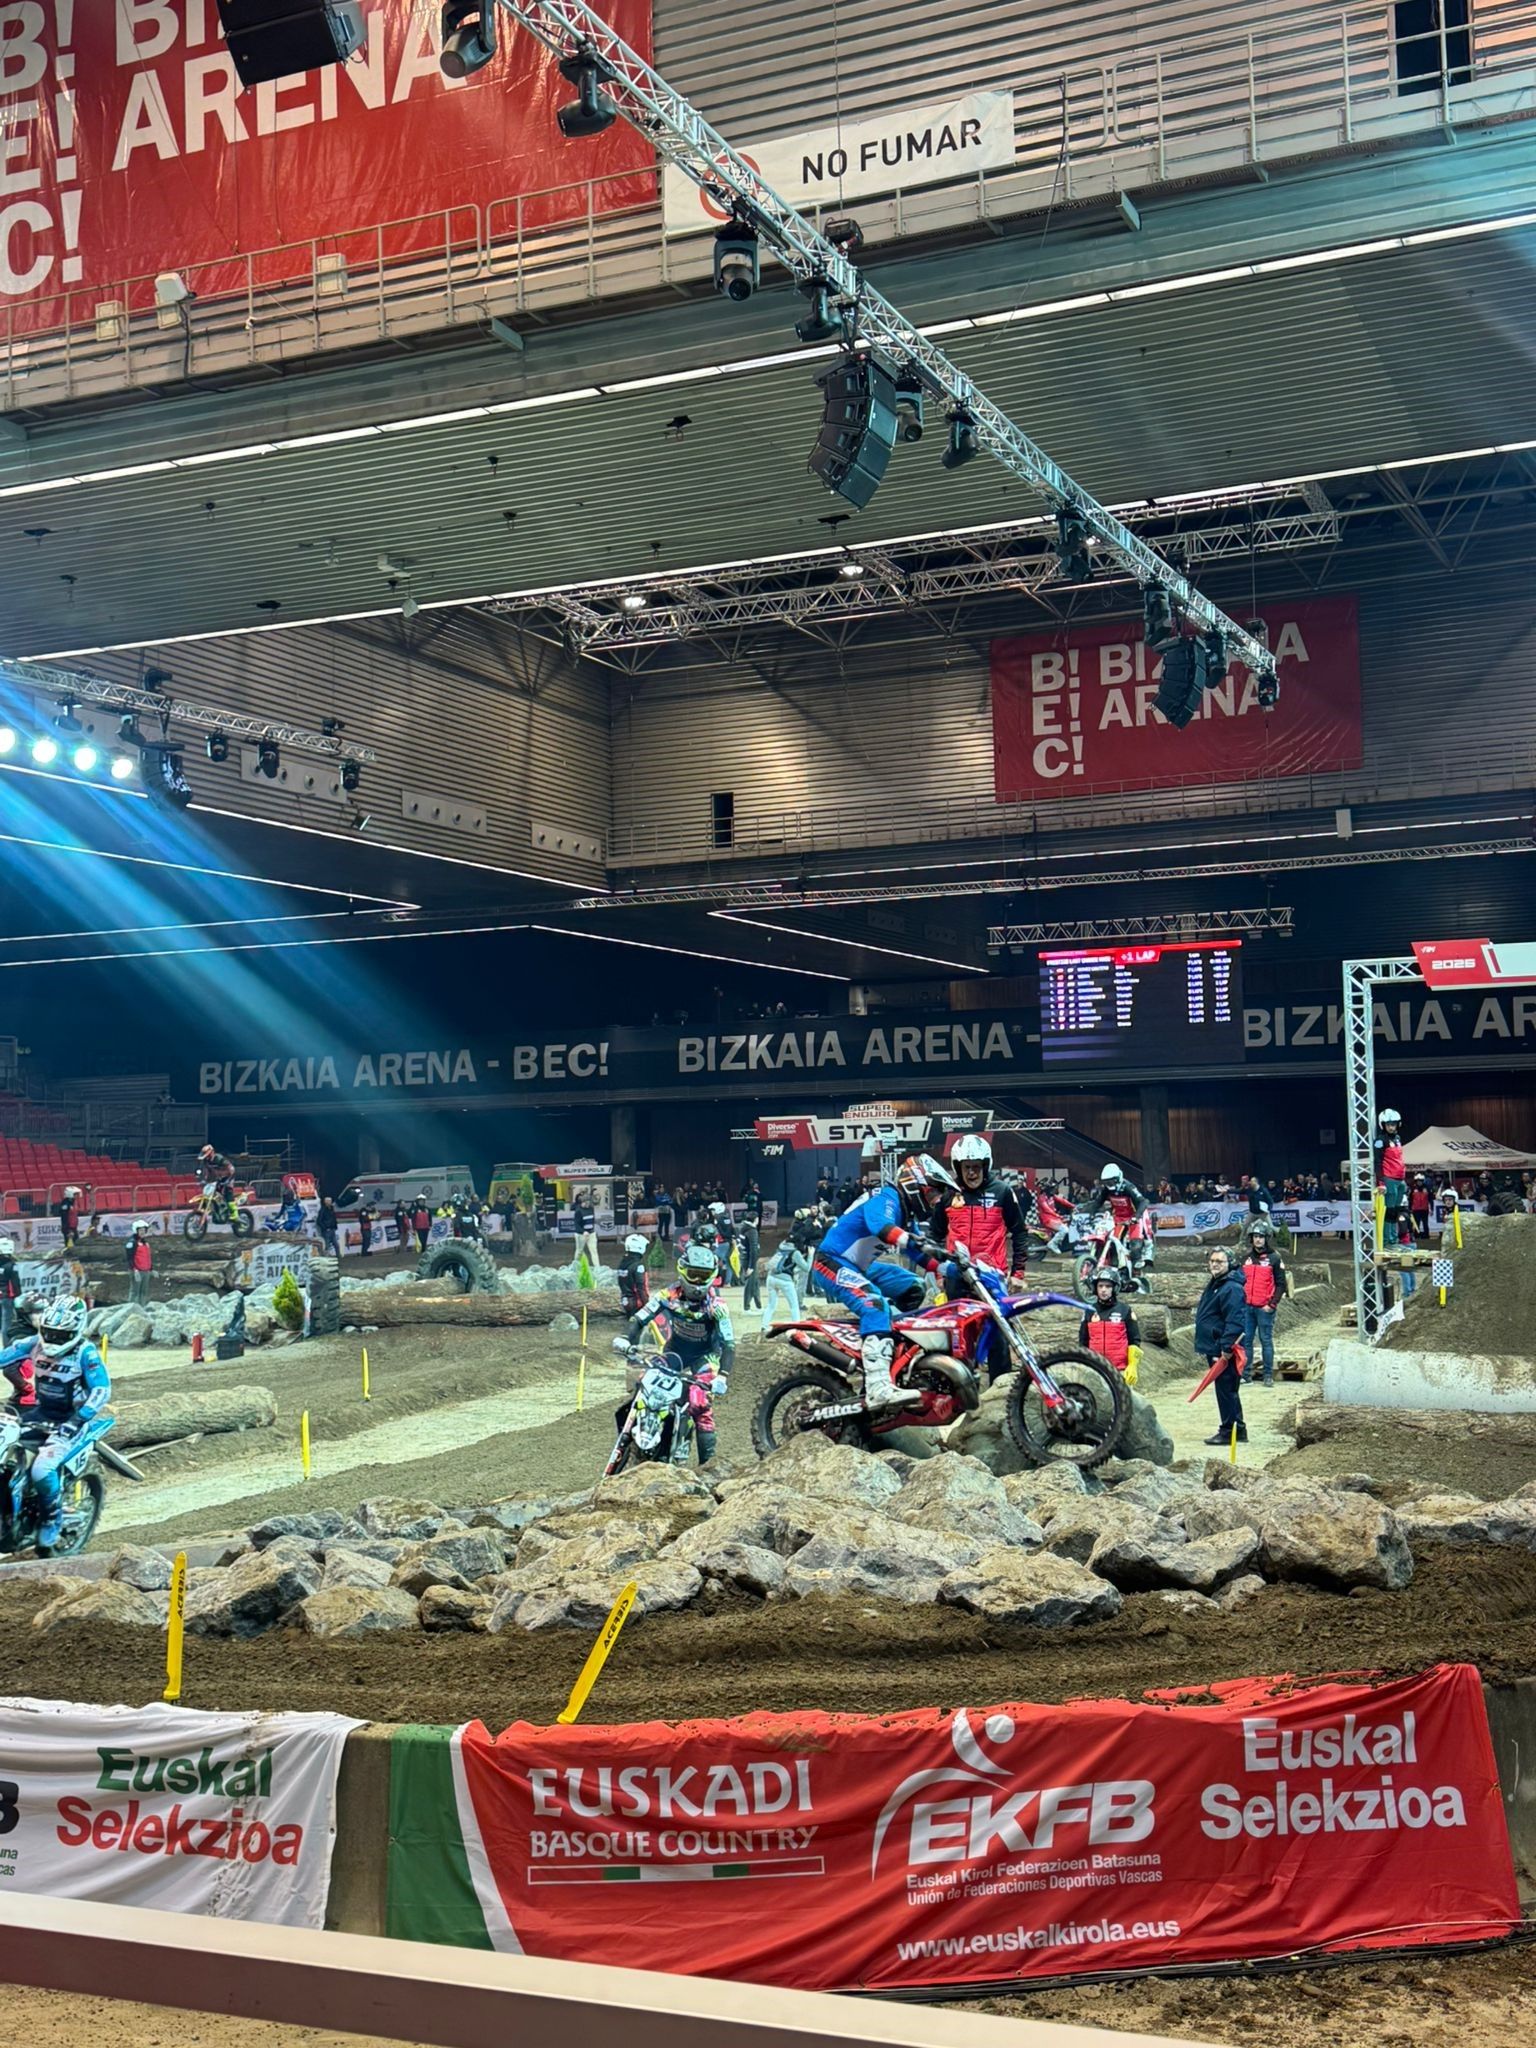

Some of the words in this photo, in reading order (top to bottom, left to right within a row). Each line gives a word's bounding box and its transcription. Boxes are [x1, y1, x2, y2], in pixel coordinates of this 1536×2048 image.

[801, 150, 848, 184] NO
[860, 118, 982, 172] FUMAR
[0, 189, 83, 296] C!
[1031, 649, 1081, 693] B!
[1032, 692, 1082, 736] E!
[1098, 672, 1275, 730] ARNA
[1032, 735, 1085, 779] C!
[199, 1056, 340, 1093] BIZKAIA
[353, 1049, 477, 1088] ARENA
[513, 1042, 610, 1080] BEC!
[678, 1030, 846, 1073] BIZKAIA
[862, 1022, 1014, 1066] ARENA
[843, 1110, 896, 1119] ENDURO
[849, 1104, 892, 1112] SUPER
[809, 1402, 864, 1422] Mitas
[1242, 1710, 1417, 1773] Euskal
[95, 1747, 276, 1798] Euskal
[526, 1759, 814, 1819] EUSKADI
[56, 1796, 304, 1866] Selekzioa
[908, 1779, 1155, 1866] EKFB
[1200, 1776, 1467, 1841] Selekzioa
[529, 1829, 650, 1860] BASQUE
[658, 1825, 819, 1858] COUNTRY
[906, 1873, 957, 1889] Euskal
[960, 1864, 994, 1883] Kirol
[996, 1855, 1088, 1877] Federazioen
[1091, 1852, 1161, 1869] Batasuna
[907, 1888, 944, 1906] Unión
[947, 1887, 961, 1900] de
[963, 1877, 1047, 1898] Federaciones
[1049, 1872, 1116, 1892] Deportivas
[1119, 1869, 1163, 1884] Vascas
[897, 1918, 1181, 1961] www.euskalkirola.eus
